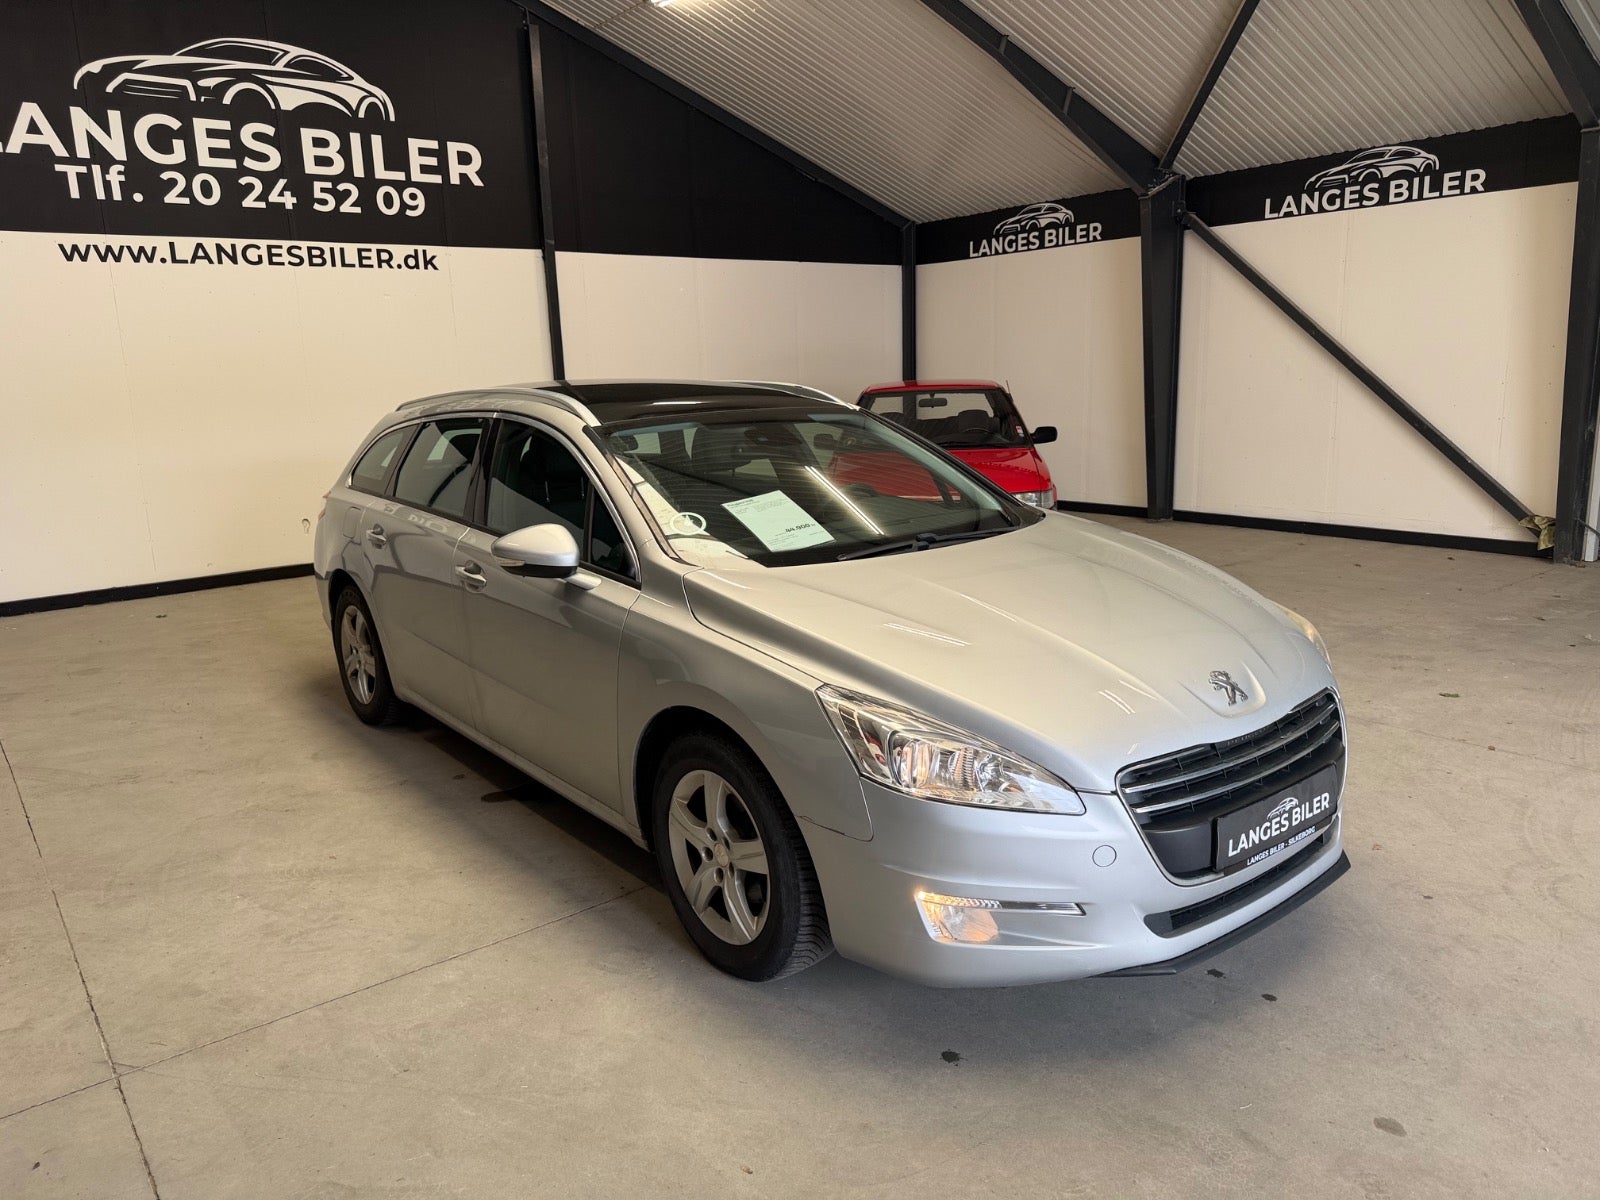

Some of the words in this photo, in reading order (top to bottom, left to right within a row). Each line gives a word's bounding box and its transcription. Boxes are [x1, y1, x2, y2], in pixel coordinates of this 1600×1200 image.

[0, 101, 282, 172] ANGES
[300, 127, 485, 187] BILER
[54, 163, 144, 203] Tlf.
[160, 170, 221, 206] 20
[237, 176, 297, 211] 24
[312, 181, 363, 214] 52
[376, 186, 427, 217] 09
[1264, 182, 1380, 219] LANGES
[1389, 168, 1487, 203] BILER
[57, 241, 439, 272] www.LANGESBILER.dk
[969, 231, 1040, 258] LANGES
[1044, 222, 1103, 248] BILER
[1228, 812, 1290, 857] LANGES
[1292, 792, 1330, 826] BILER
[1247, 850, 1269, 866] LANGES
[1269, 842, 1286, 855] BILER
[1288, 826, 1316, 846] SILKEBORG
